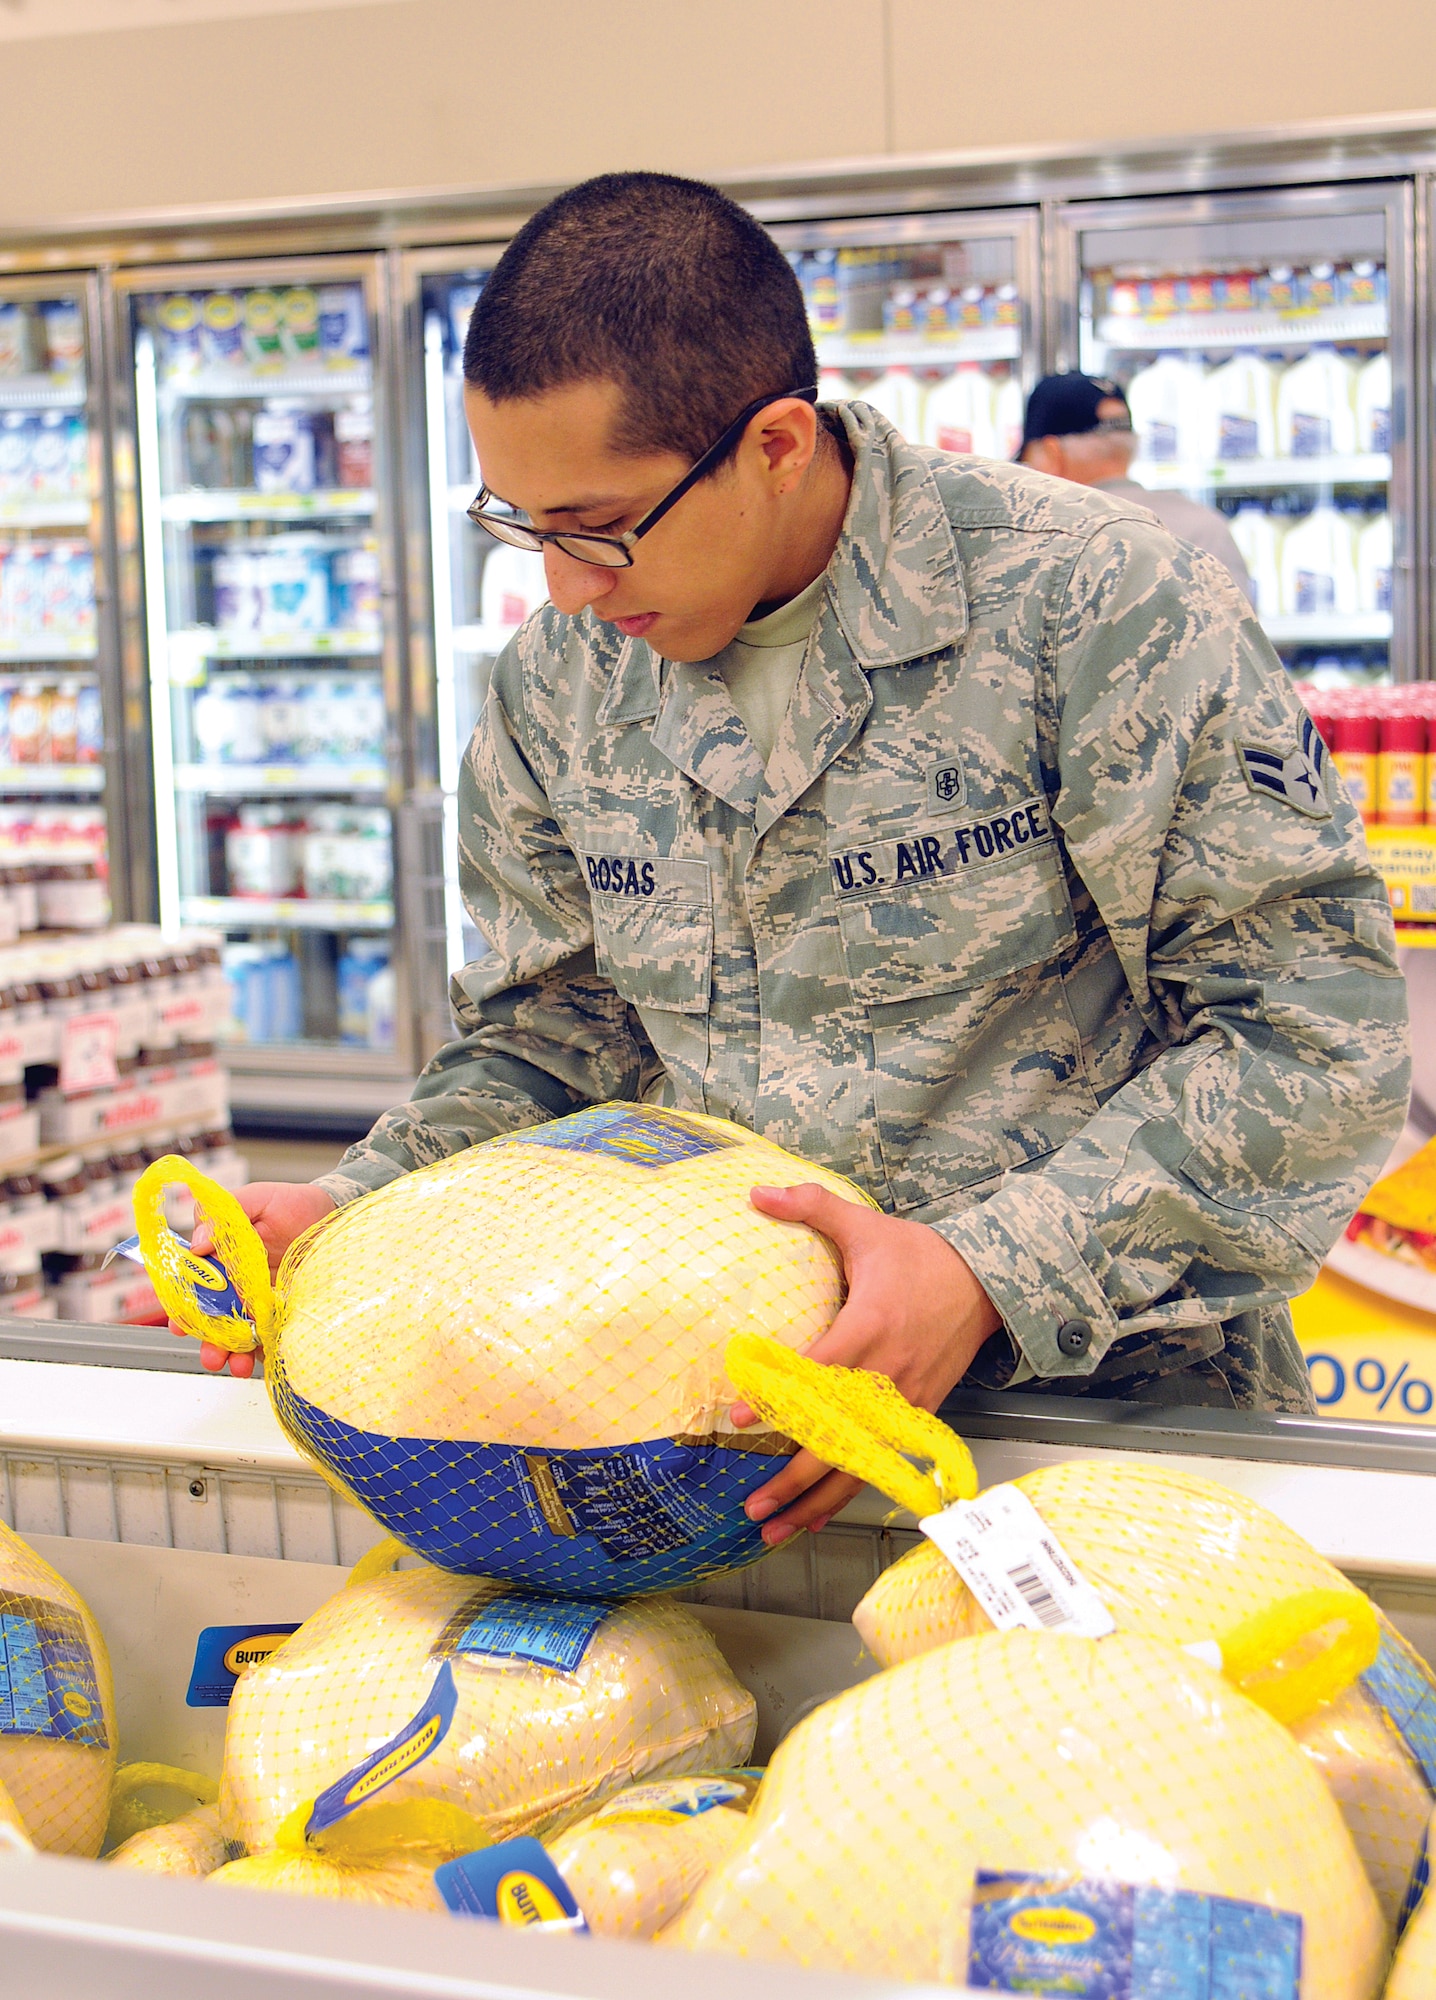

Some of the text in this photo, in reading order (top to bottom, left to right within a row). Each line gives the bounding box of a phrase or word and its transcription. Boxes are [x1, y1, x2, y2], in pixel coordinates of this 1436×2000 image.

[834, 804, 1048, 889] U.S. AIR FORCE
[1391, 849, 1433, 860] easy
[585, 855, 655, 896] ROSAS
[360, 1727, 433, 1791] BUTTERBALL
